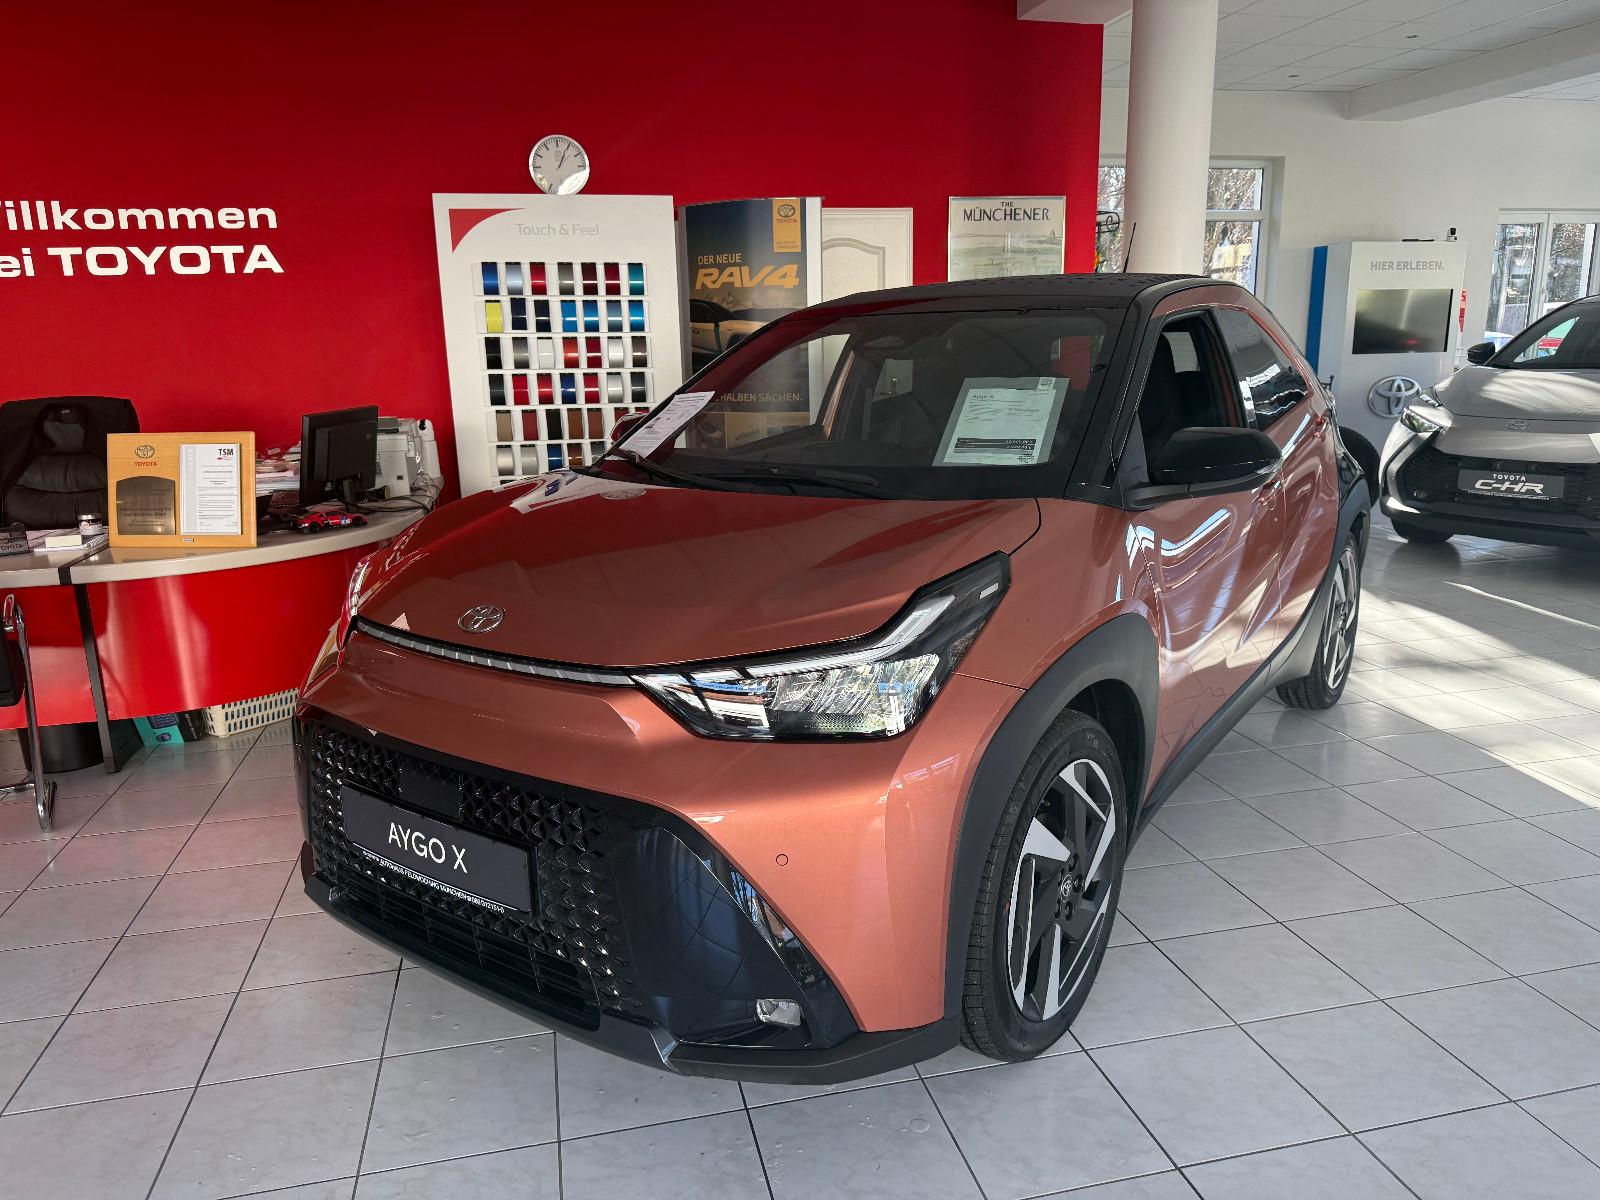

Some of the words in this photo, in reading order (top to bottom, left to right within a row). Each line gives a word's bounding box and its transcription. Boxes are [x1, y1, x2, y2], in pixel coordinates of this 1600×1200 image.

[0, 200, 278, 231] illkommen
[963, 207, 1050, 221] MÜNCHENER
[516, 223, 556, 235] Touch
[559, 223, 569, 235] &
[572, 223, 599, 235] Feel
[0, 247, 35, 278] ei
[47, 244, 285, 276] TOYOTA
[698, 255, 715, 265] DER
[716, 253, 742, 264] NEUE
[1370, 261, 1394, 271] HIER
[1396, 261, 1444, 271] ERLEBEN.
[695, 264, 800, 290] RAV4
[218, 448, 234, 456] TSM
[1492, 473, 1526, 482] TOYOTA
[1474, 479, 1544, 494] C-HR
[0, 542, 24, 551] OYOTA
[388, 822, 447, 864] AYGO
[451, 844, 469, 874] X
